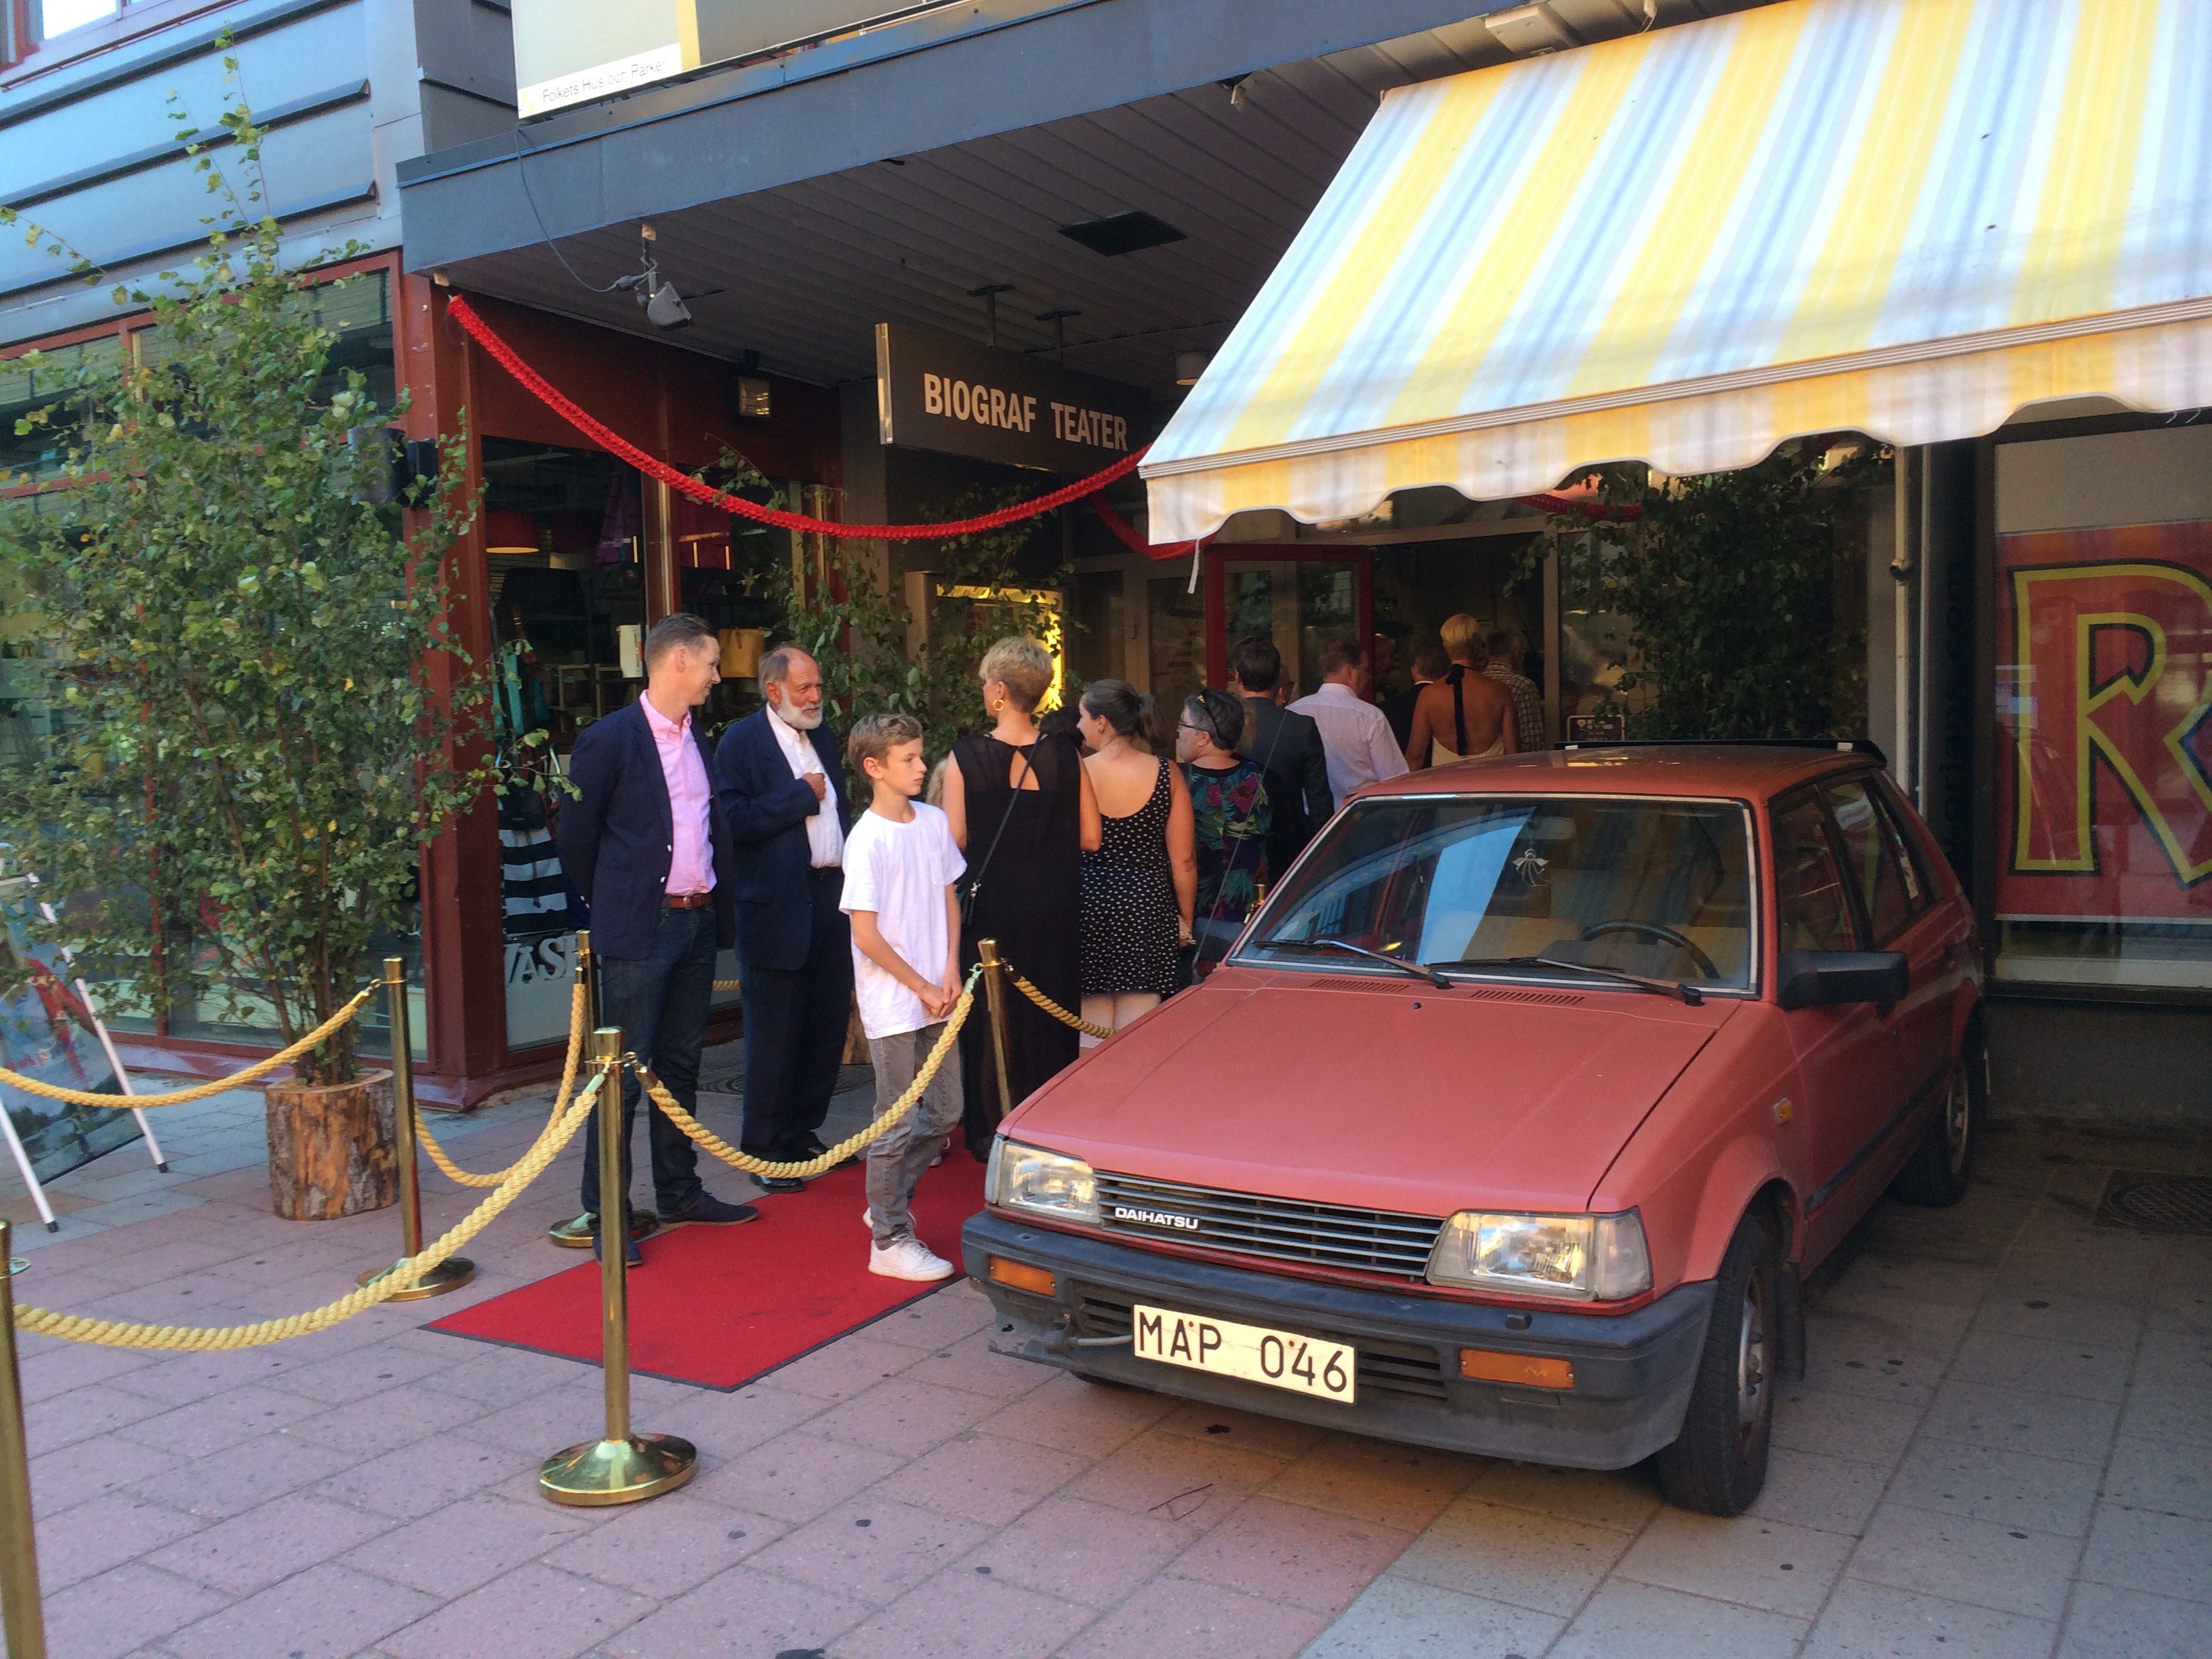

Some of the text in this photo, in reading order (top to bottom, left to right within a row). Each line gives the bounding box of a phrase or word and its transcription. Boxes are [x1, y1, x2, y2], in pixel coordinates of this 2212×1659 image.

[542, 85, 579, 102] Folkets
[583, 76, 604, 92] Hus
[631, 59, 666, 78] Parker
[924, 373, 1128, 452] BIOGRAF TEATER
[1115, 1207, 1198, 1229] DAIHATSU
[1139, 1312, 1347, 1393] MAP 046
